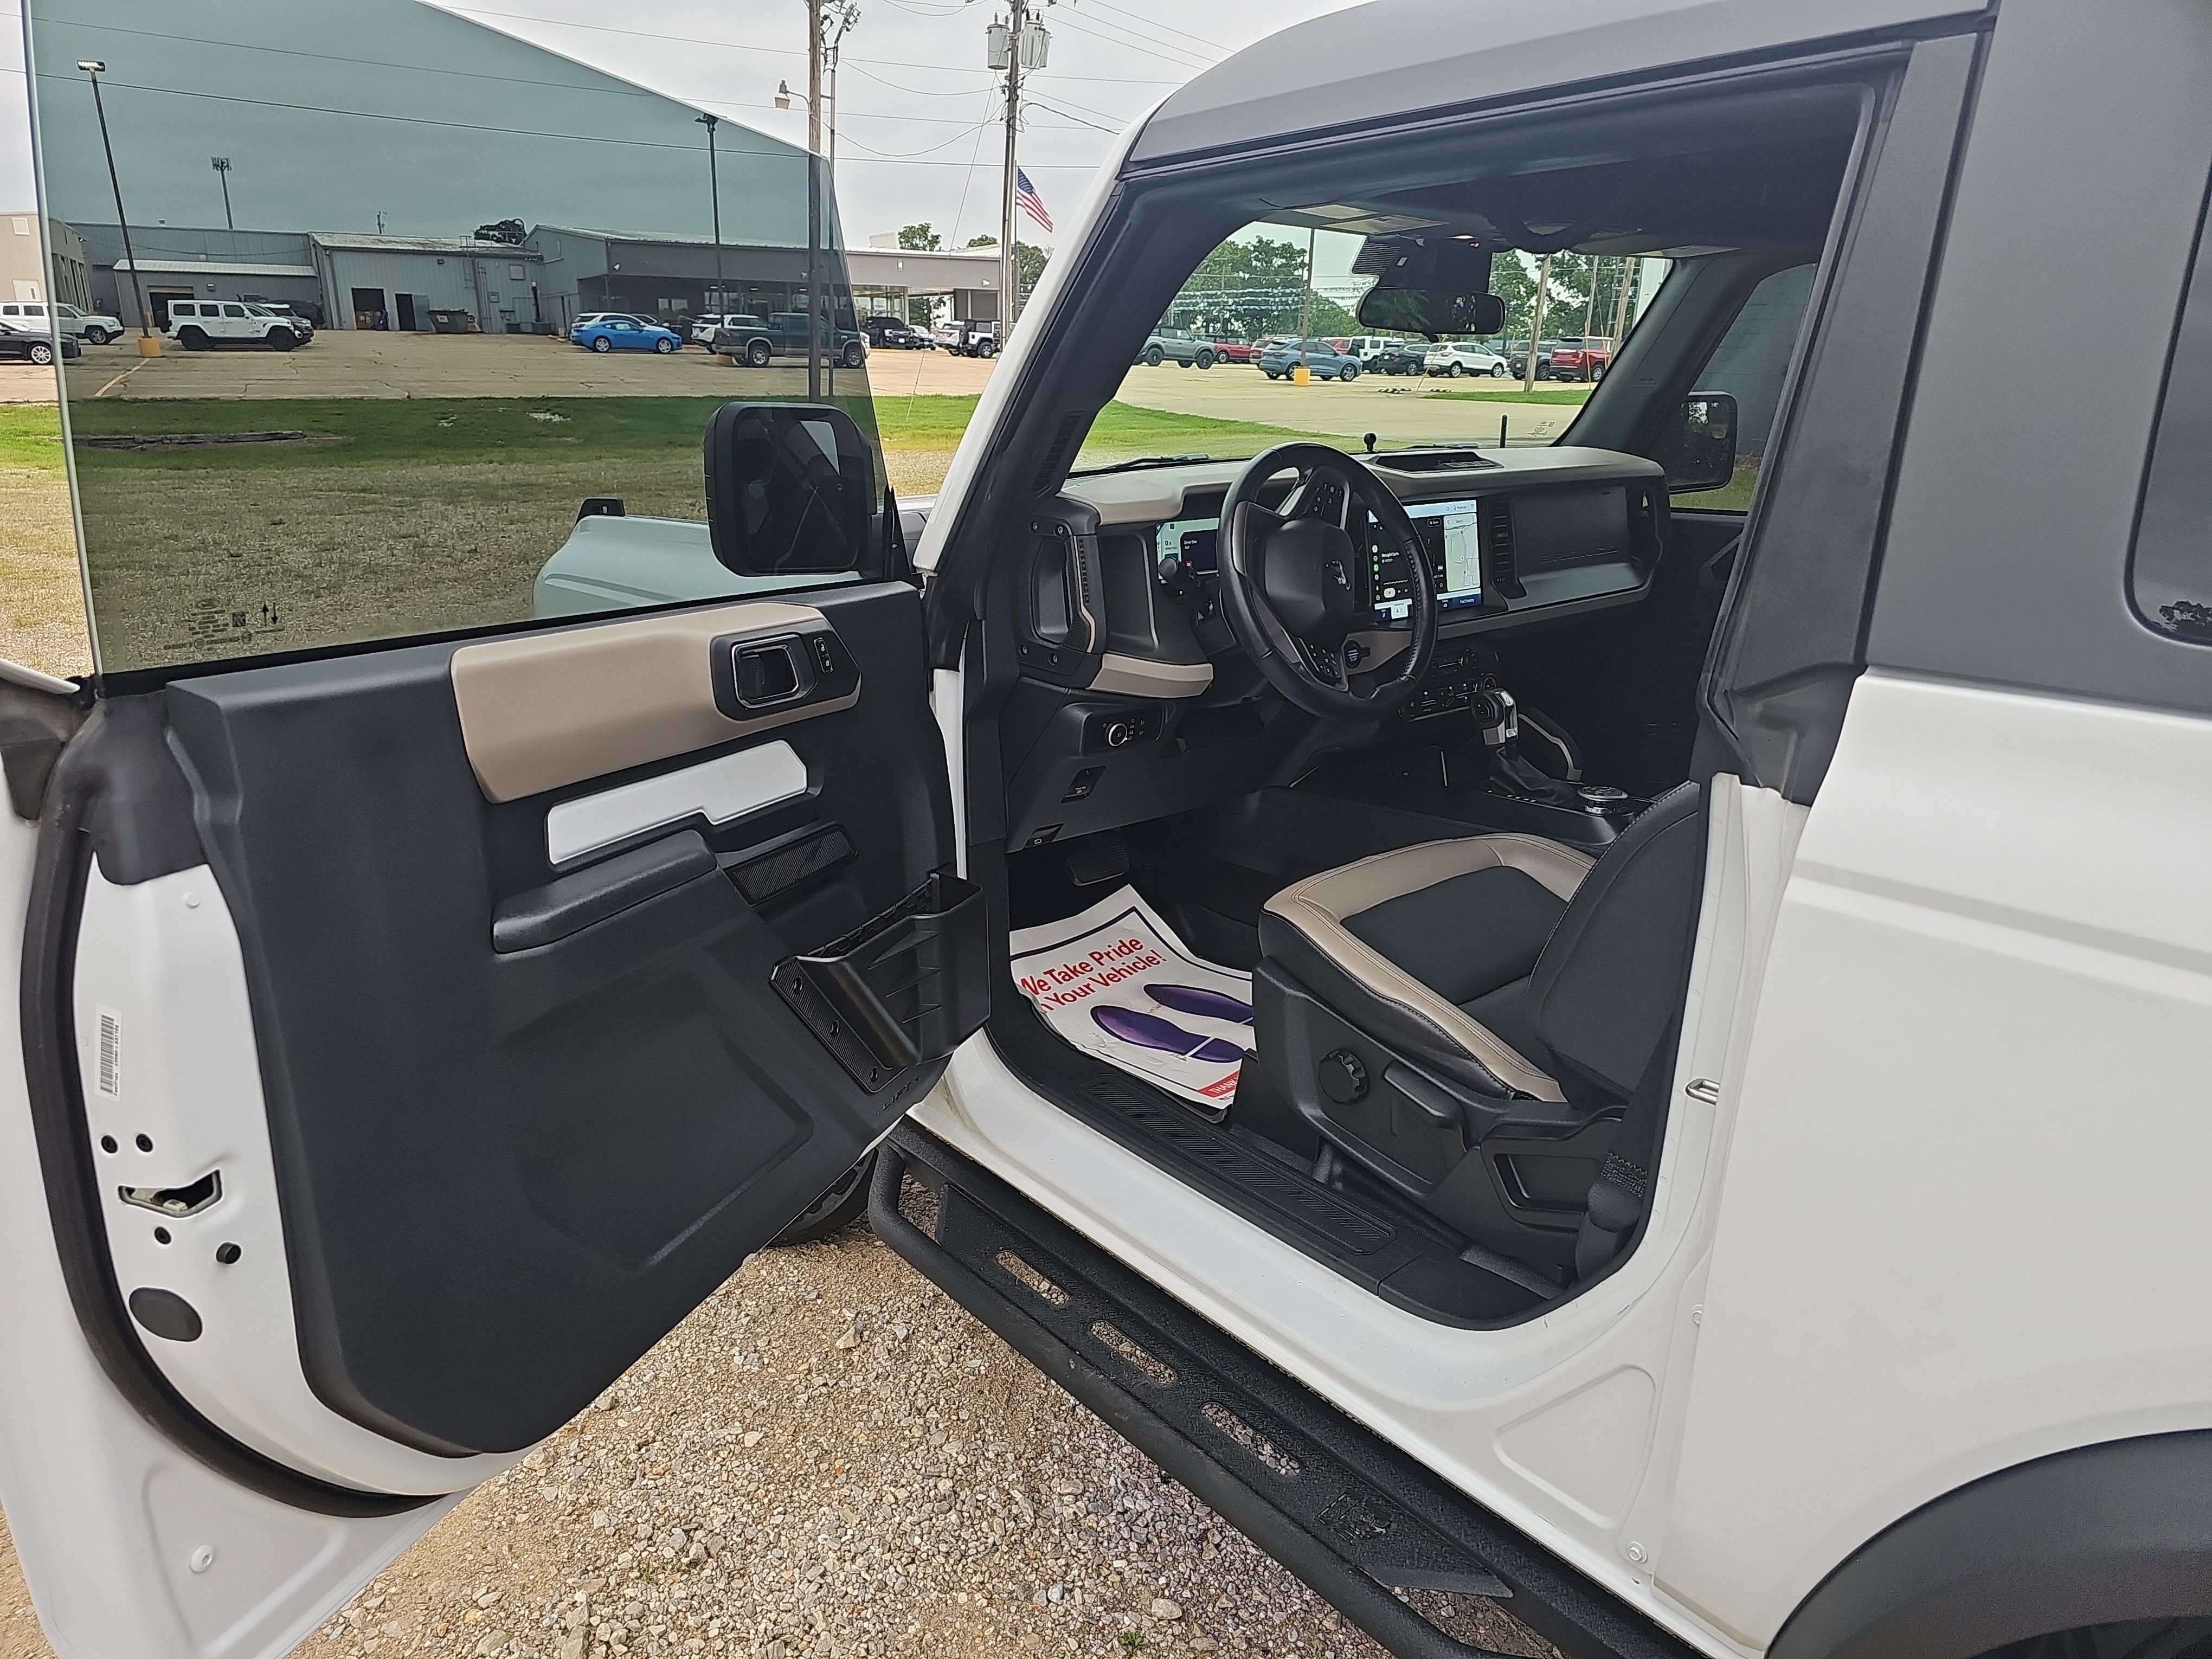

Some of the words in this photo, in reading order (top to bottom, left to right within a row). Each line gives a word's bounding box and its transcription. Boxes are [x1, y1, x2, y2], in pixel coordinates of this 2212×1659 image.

[1043, 961, 1094, 985] Take
[1088, 938, 1143, 967] Pride
[1043, 982, 1096, 1007] Your
[1087, 949, 1167, 987] Vehicle!
[883, 1081, 911, 1111] LIFT
[1207, 1078, 1238, 1094] THANK
